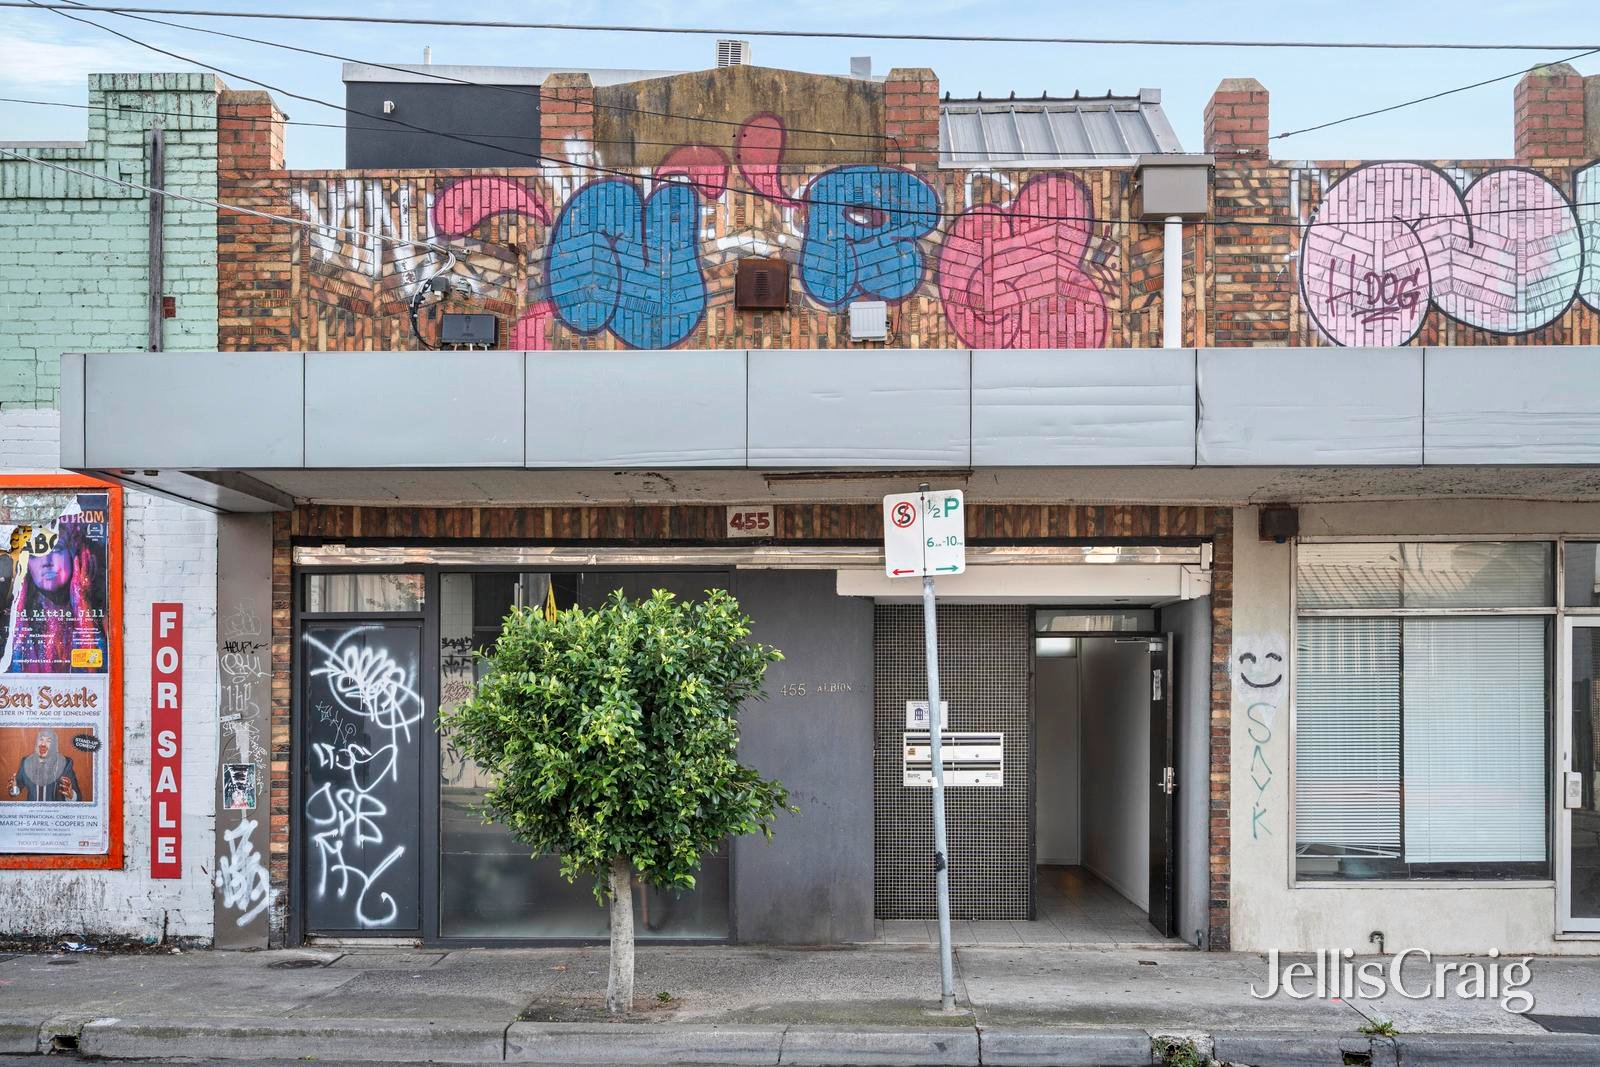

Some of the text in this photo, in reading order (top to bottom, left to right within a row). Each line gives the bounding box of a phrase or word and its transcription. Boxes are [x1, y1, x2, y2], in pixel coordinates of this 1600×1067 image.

[944, 497, 960, 518] P
[730, 511, 770, 531] 455
[33, 610, 72, 618] Little
[80, 610, 105, 618] Jill
[39, 685, 98, 709] Searle
[780, 683, 806, 697] 455
[155, 611, 179, 864] FOR SALE
